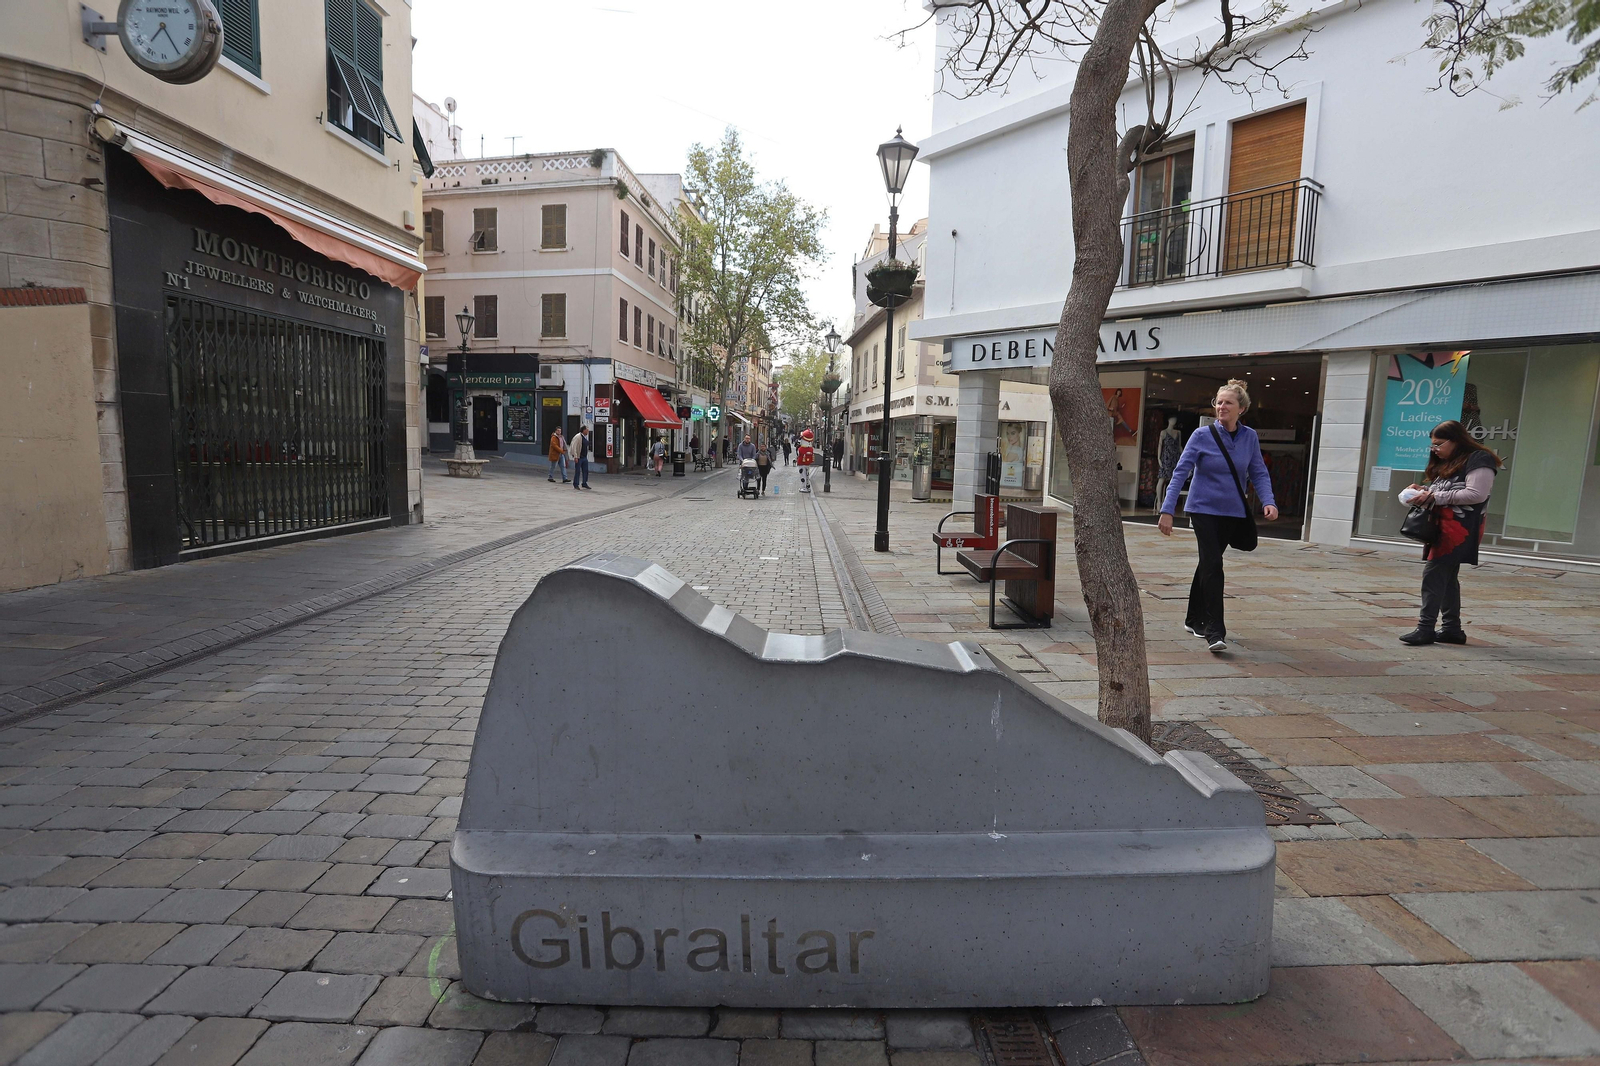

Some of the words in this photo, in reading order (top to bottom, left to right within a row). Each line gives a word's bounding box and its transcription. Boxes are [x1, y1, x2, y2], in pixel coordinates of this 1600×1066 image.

[186, 260, 275, 294] JEWELLERS
[282, 288, 291, 299] &
[298, 290, 377, 320] WATCHMAKERS
[971, 327, 1161, 362] DEBENMS
[504, 375, 522, 385] Inn
[925, 395, 953, 406] S.M.
[1397, 378, 1451, 406] 20%
[1400, 411, 1442, 422] Ladies
[1386, 426, 1431, 439] Sleepw
[510, 908, 876, 976] Gibraltar
